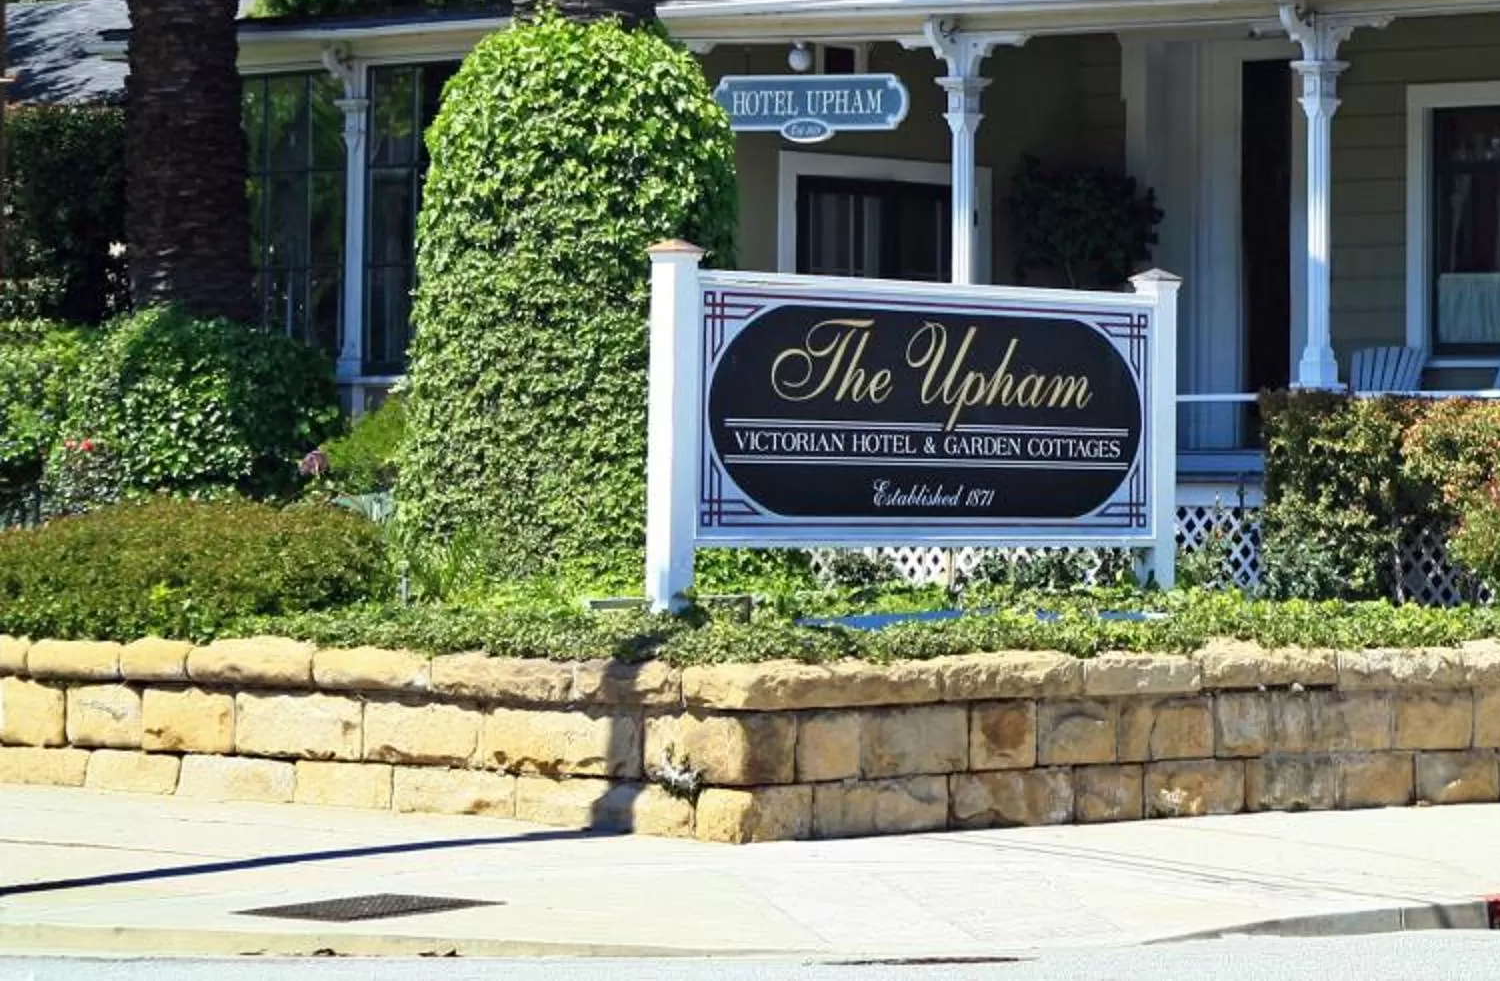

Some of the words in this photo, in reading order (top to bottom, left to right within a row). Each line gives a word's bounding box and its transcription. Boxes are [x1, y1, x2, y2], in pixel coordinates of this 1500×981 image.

[732, 90, 799, 116] HOTEL
[807, 89, 883, 115] UPHAM
[771, 319, 893, 402] The
[905, 320, 1093, 432] Upham
[734, 430, 845, 453] VICTORIAN
[852, 433, 917, 455] HOTEL
[923, 438, 937, 456] &
[943, 434, 1022, 457] GARDEN
[1026, 439, 1121, 459] COTTAGES
[872, 479, 961, 508] Established
[964, 485, 994, 507] 1871
